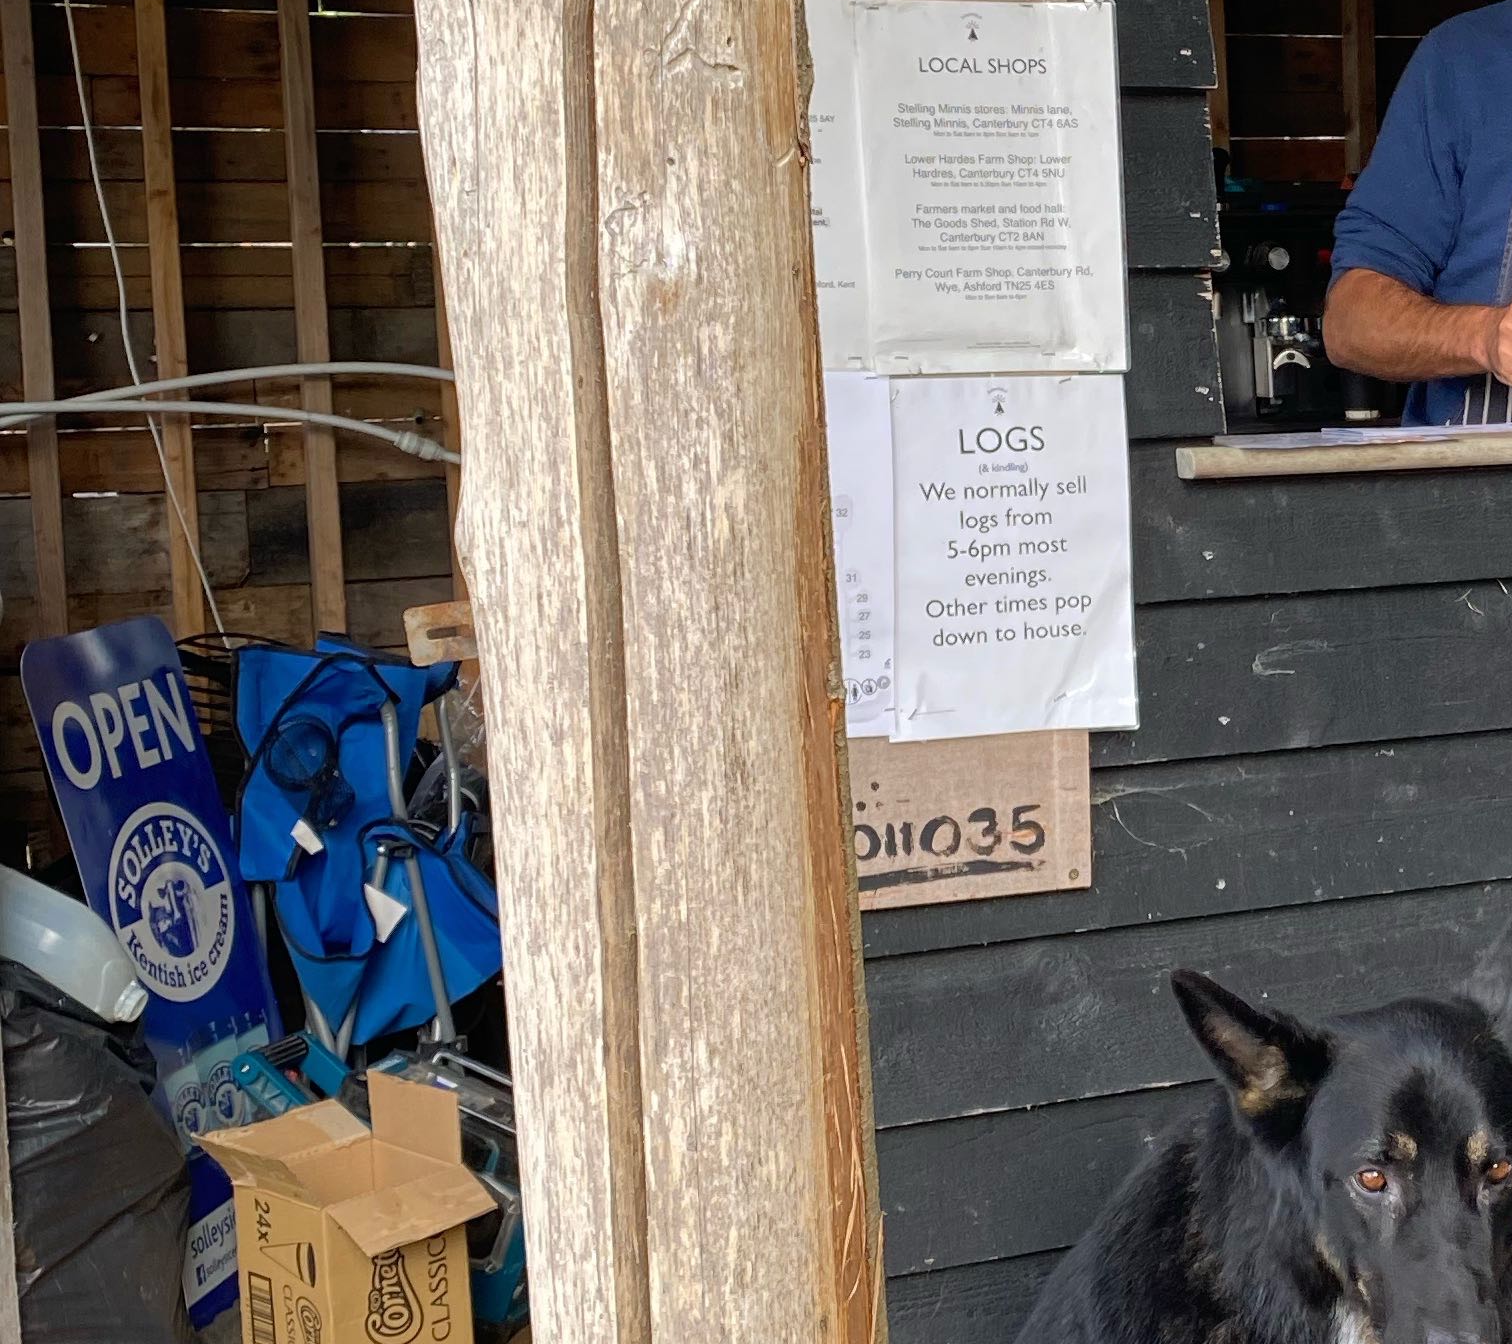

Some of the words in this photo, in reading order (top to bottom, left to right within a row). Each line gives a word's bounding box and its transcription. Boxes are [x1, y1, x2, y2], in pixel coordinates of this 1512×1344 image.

[918, 57, 982, 74] LOCAL
[988, 58, 1047, 74] SHOPS
[897, 102, 935, 116] Stelling
[938, 103, 971, 114] Minnis
[1011, 104, 1044, 114] Minnis
[893, 117, 930, 130] Stelling
[934, 118, 970, 130] Minnis,
[973, 118, 1028, 131] Canterbury
[1031, 119, 1053, 129] CT4
[904, 154, 936, 164] Lower
[938, 154, 976, 165] Hardes
[978, 154, 1004, 165] Farm
[1039, 154, 1072, 165] Lower
[912, 168, 957, 180] Hardres,
[959, 168, 1015, 180] Canterbury
[1017, 168, 1039, 178] CT4
[915, 204, 958, 214] Farmers
[960, 204, 995, 214] market
[998, 204, 1017, 214] and
[1019, 203, 1042, 214] food
[911, 218, 932, 229] The
[934, 218, 968, 229] Goods
[1002, 218, 1037, 228] Station
[1040, 218, 1055, 228] Rd
[939, 232, 995, 244] Canterbury
[998, 232, 1020, 242] CT2
[895, 268, 922, 280] Perry
[925, 268, 953, 278] Court
[956, 268, 982, 278] Farm
[1016, 267, 1072, 278] Canterbury
[963, 281, 1001, 291] Ashford
[1004, 281, 1031, 291] TN25
[1034, 280, 1055, 290] 4ES
[959, 426, 1045, 454] LOGS
[991, 462, 1029, 473] kindling)
[919, 482, 955, 501] We
[963, 477, 1049, 501] normally
[1056, 475, 1087, 495] sell
[960, 510, 999, 533] logs
[1005, 508, 1053, 527] from
[947, 539, 1011, 563] 5-6pm
[1018, 537, 1068, 555] most
[965, 567, 1052, 588] evenings.
[926, 597, 989, 618] Other
[995, 595, 1048, 614] times
[1055, 594, 1092, 615] pop
[858, 612, 871, 621] 27
[932, 628, 987, 647] down
[995, 628, 1016, 642] to
[1023, 622, 1087, 640] house.
[52, 672, 196, 790] OPEN
[118, 819, 211, 908] SOLLEY'S
[126, 930, 186, 988] Kentish
[187, 960, 209, 985] ice
[209, 894, 228, 966] cream
[191, 1206, 236, 1258] solleysi
[427, 1233, 451, 1342] CLASSIC
